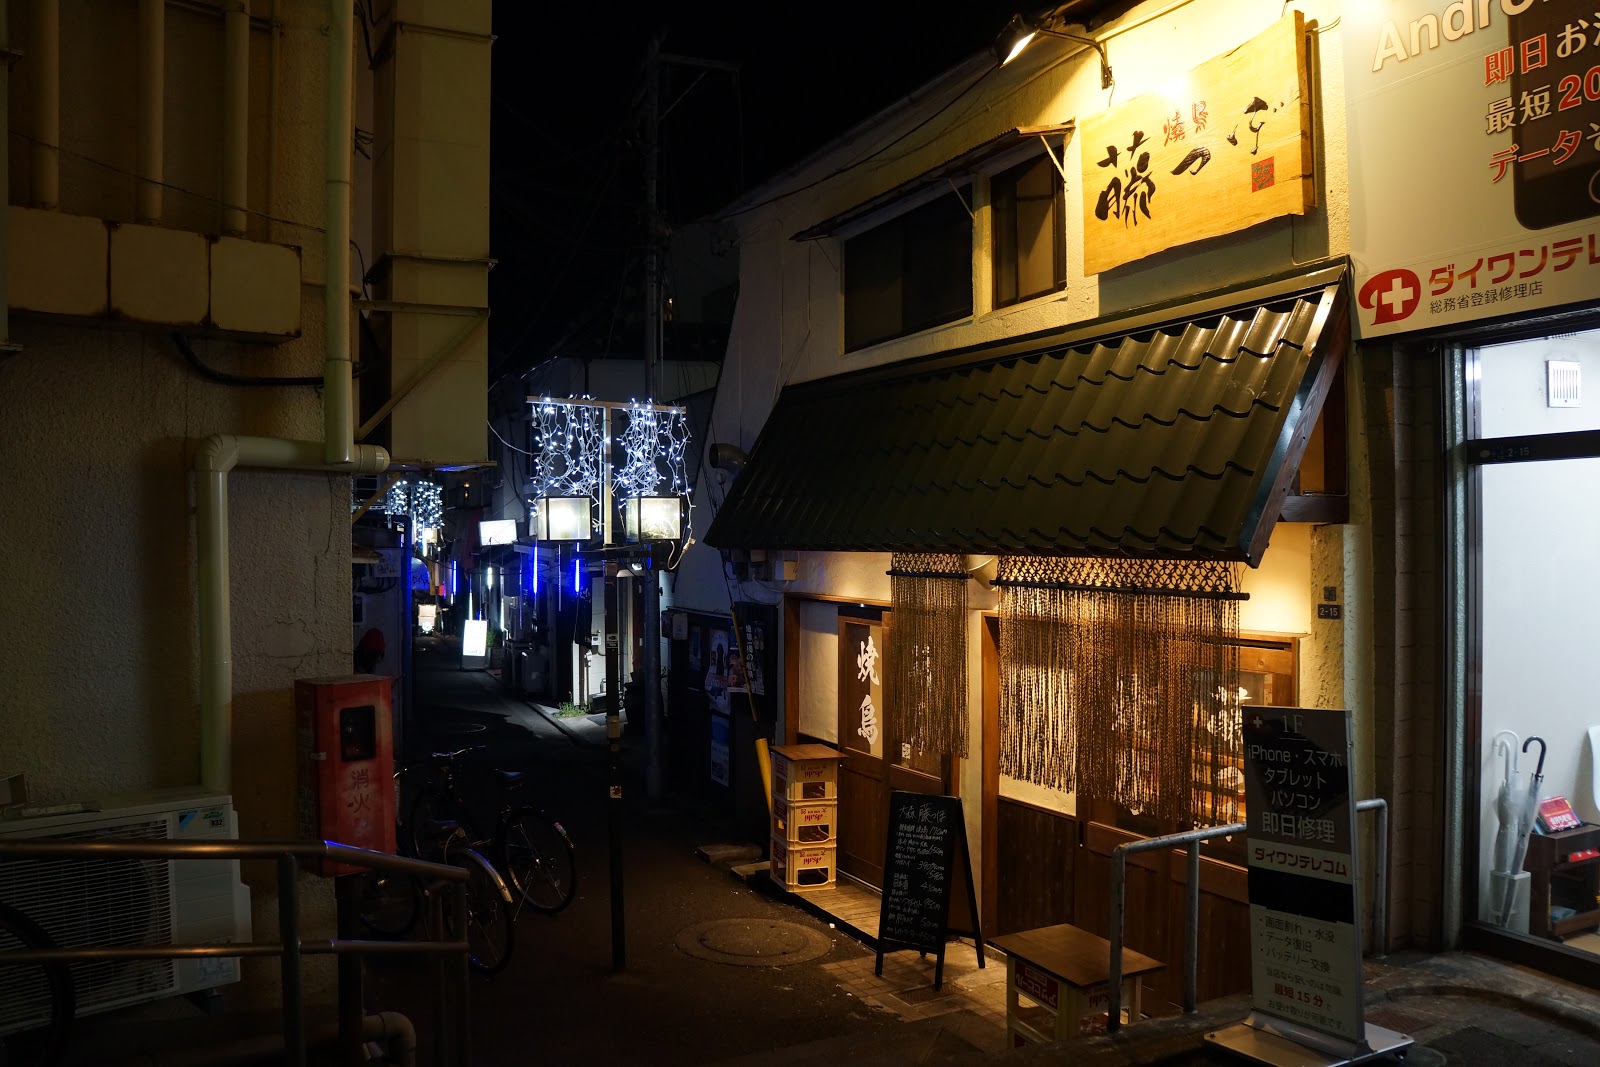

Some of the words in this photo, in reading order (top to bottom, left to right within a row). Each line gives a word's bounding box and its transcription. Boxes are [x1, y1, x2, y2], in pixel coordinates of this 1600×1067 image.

[1371, 0, 1550, 73] Andro
[1428, 233, 1600, 297] ダイワンテ
[1429, 281, 1543, 315] 総務省登録修理店
[1319, 607, 1339, 617] 2-15
[1282, 714, 1304, 734] 1F
[1264, 767, 1327, 790] タブレット
[1271, 790, 1321, 811] パソコン
[1261, 811, 1336, 844] 即日修理
[1254, 847, 1348, 877] ダイワンテレコム
[1015, 973, 1057, 1007] アサヒビール
